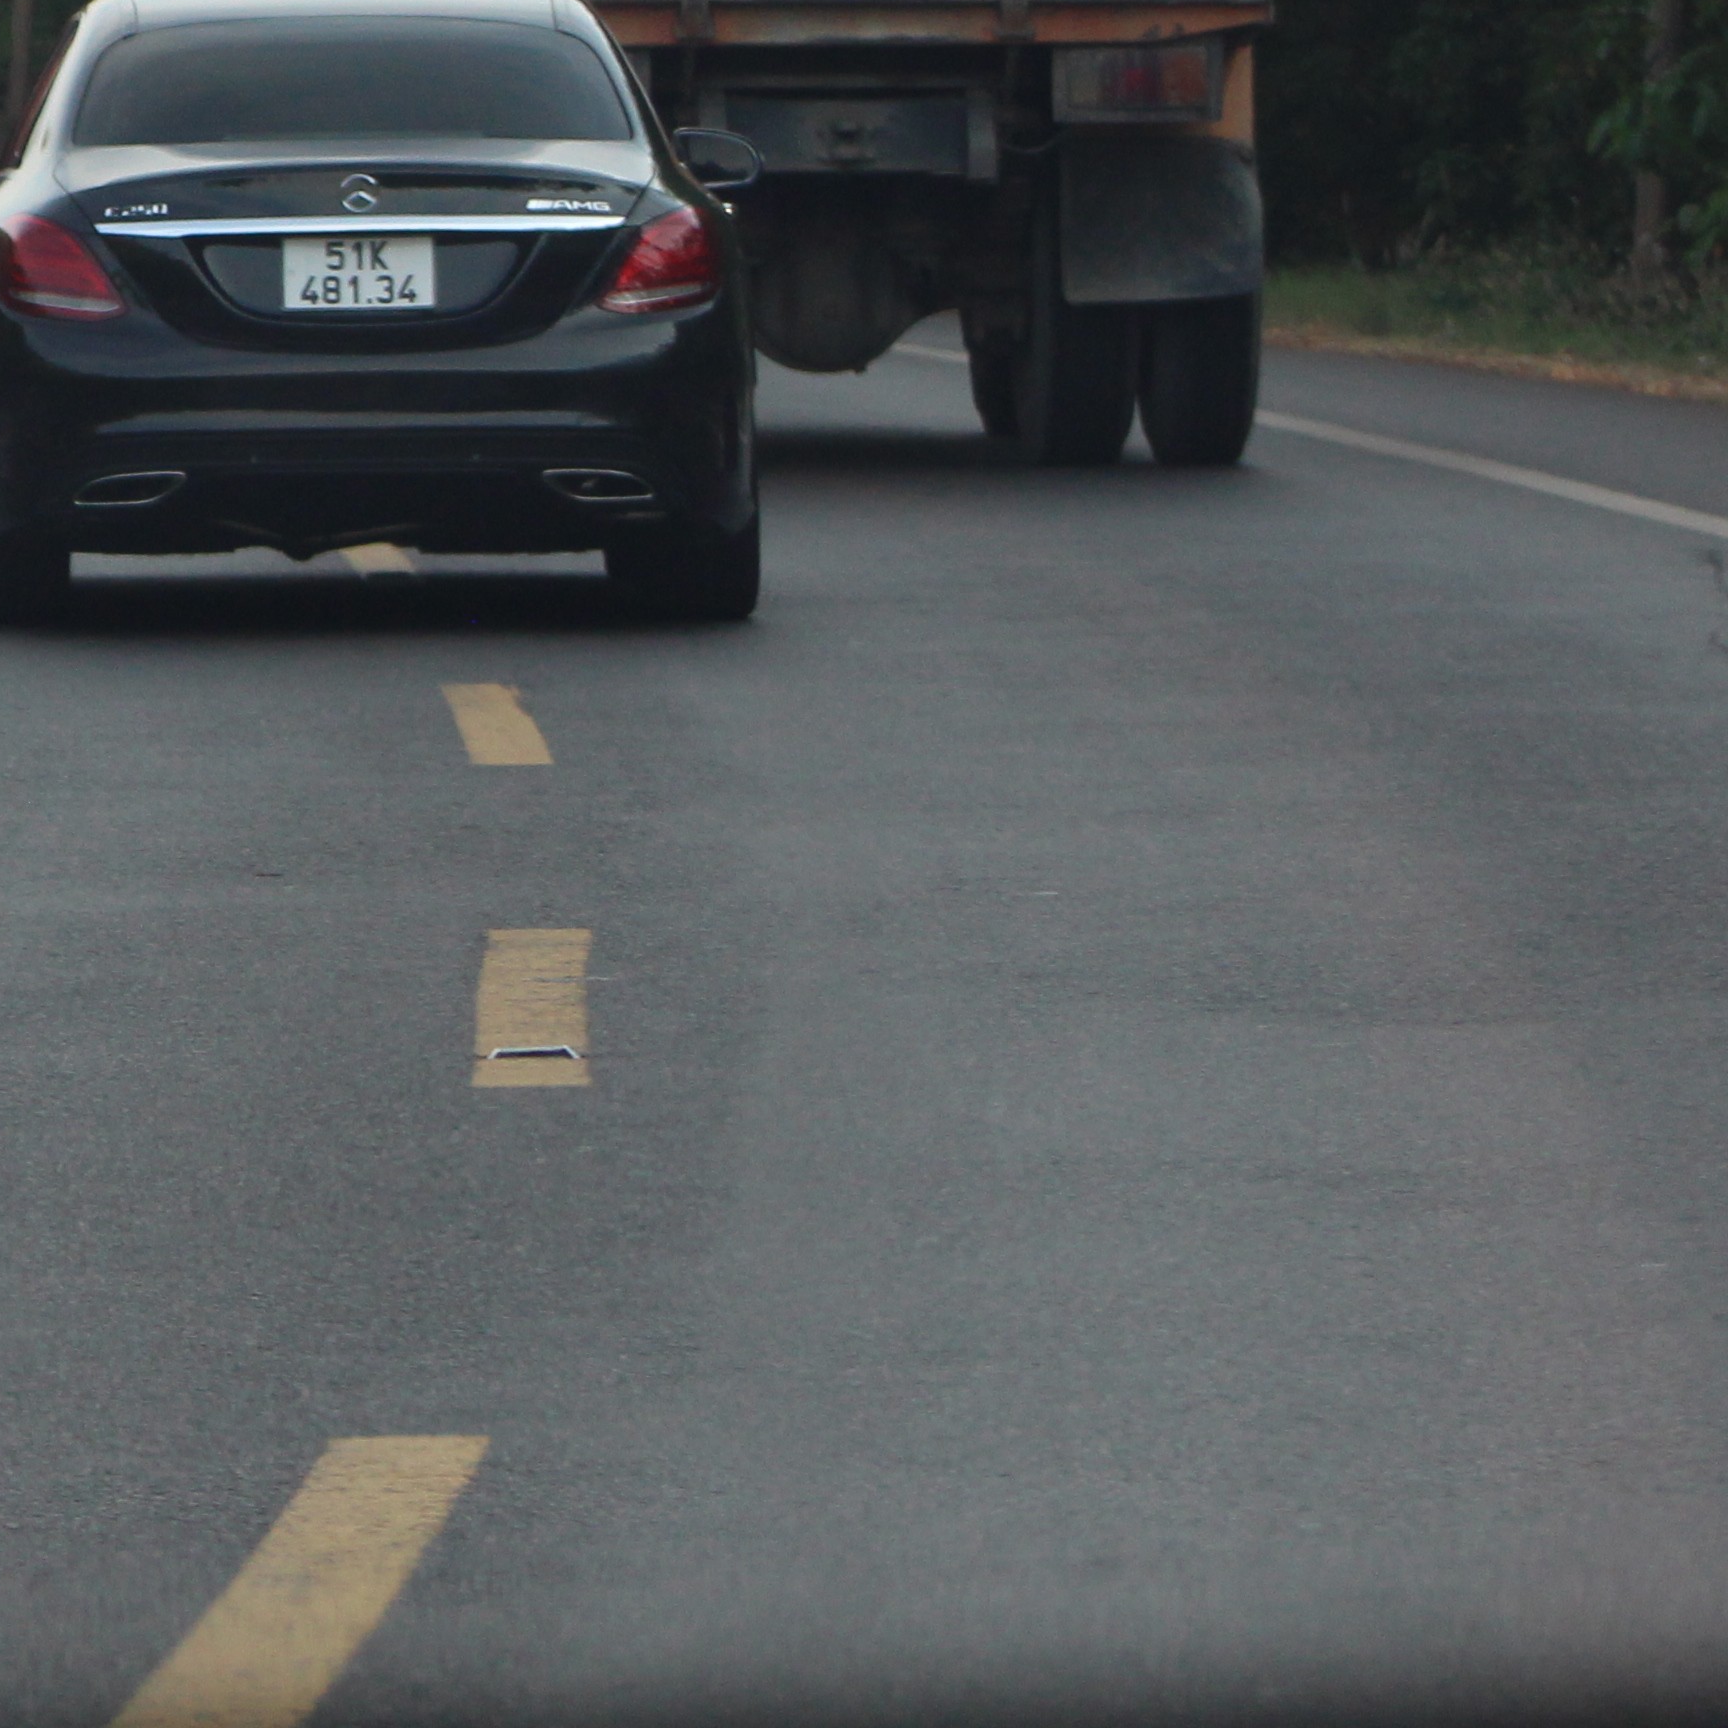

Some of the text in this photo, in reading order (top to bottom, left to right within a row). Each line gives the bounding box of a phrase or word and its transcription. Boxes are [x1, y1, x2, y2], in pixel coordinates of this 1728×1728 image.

[552, 198, 611, 212] AMG
[325, 240, 389, 271] 51K
[300, 274, 417, 305] 481.34
